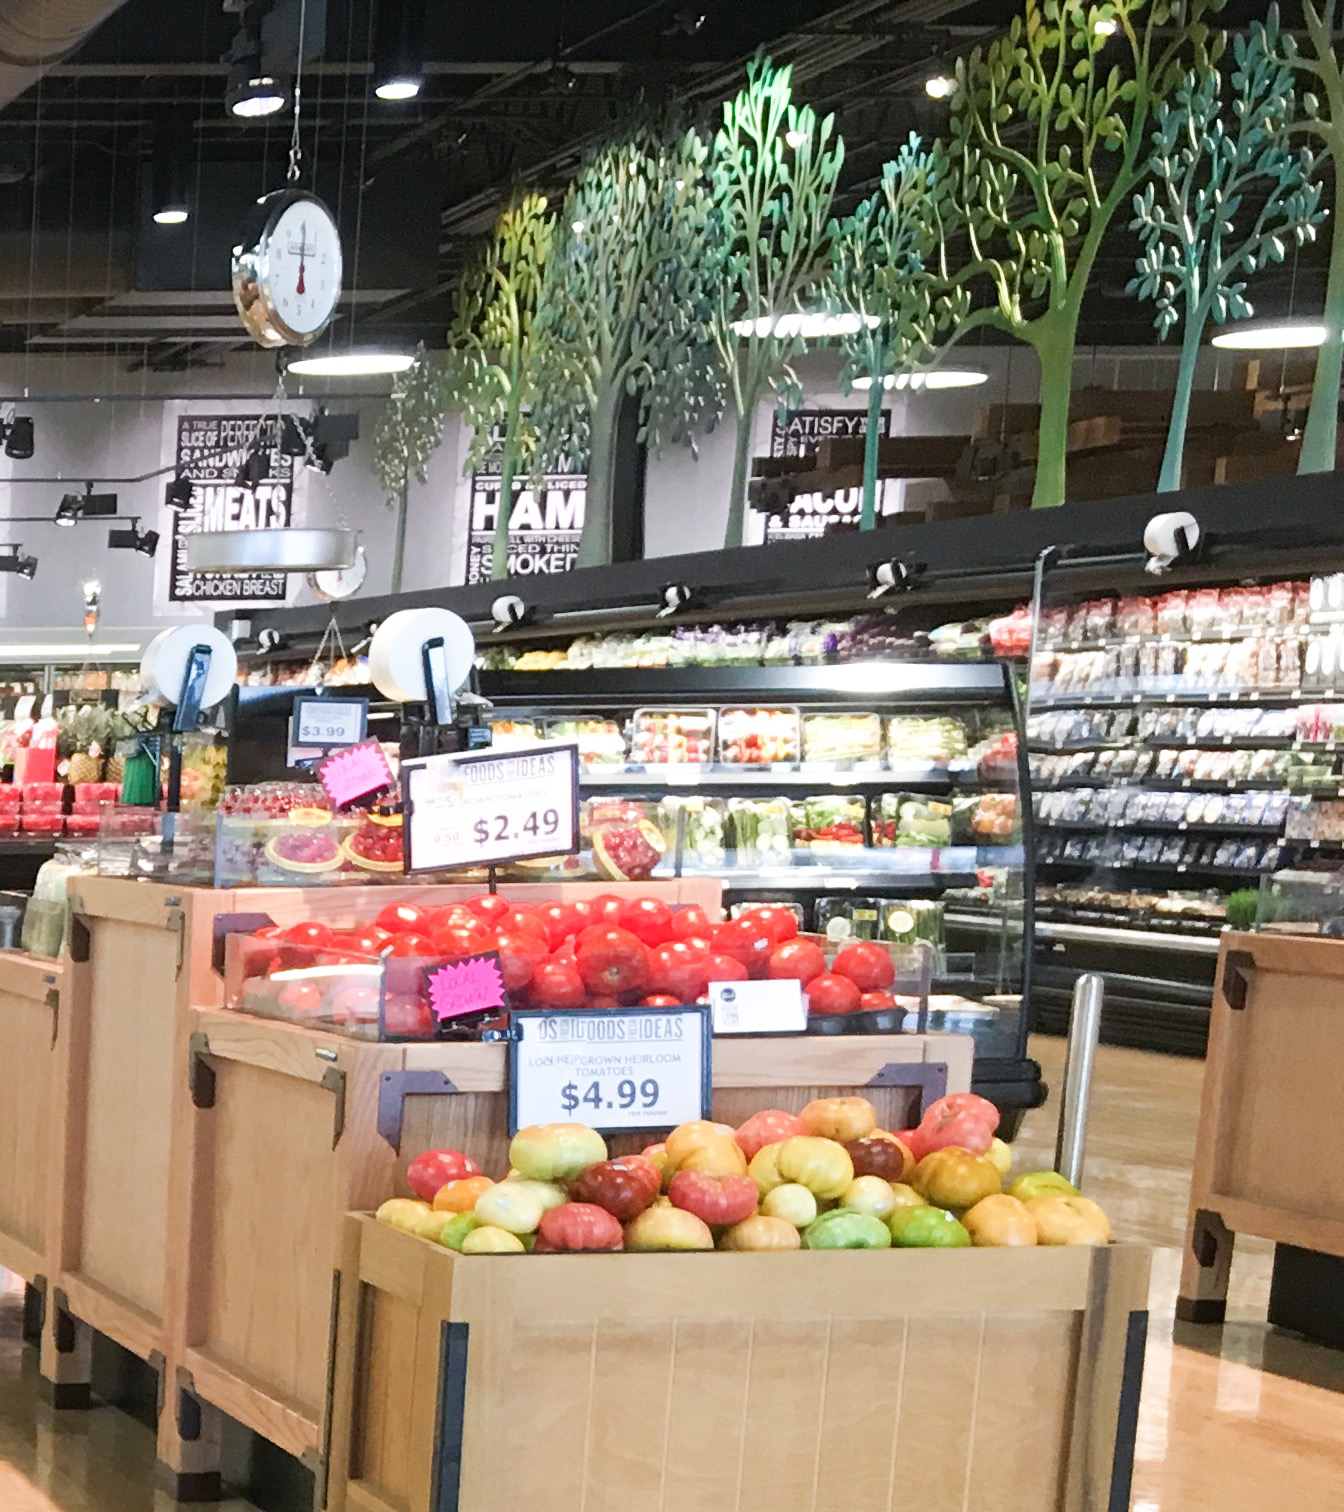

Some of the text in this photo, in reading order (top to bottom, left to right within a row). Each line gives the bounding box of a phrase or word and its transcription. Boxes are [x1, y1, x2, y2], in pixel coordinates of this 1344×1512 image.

[193, 421, 218, 430] TRUE
[784, 416, 858, 434] ATISFY
[180, 431, 218, 447] SLICE OF
[180, 449, 292, 468] SANDWIES
[180, 468, 291, 478] AND SNKS
[475, 480, 587, 490] CURD LICED
[789, 479, 883, 514] ACON
[204, 485, 287, 533] MEATS
[472, 490, 587, 530] HAM
[768, 514, 783, 528] &
[192, 579, 285, 597] CHICKEN BREAST
[301, 725, 345, 737] $3.99
[516, 755, 555, 778] IDEAS
[496, 790, 547, 802] TOMATOES
[473, 808, 559, 849] $2.49
[639, 1018, 684, 1039] IDEAS
[580, 1055, 622, 1066] GROWN
[625, 1053, 682, 1064] HEIRLOOM
[575, 1066, 634, 1077] TOMATOES
[561, 1079, 660, 1117] $4.99
